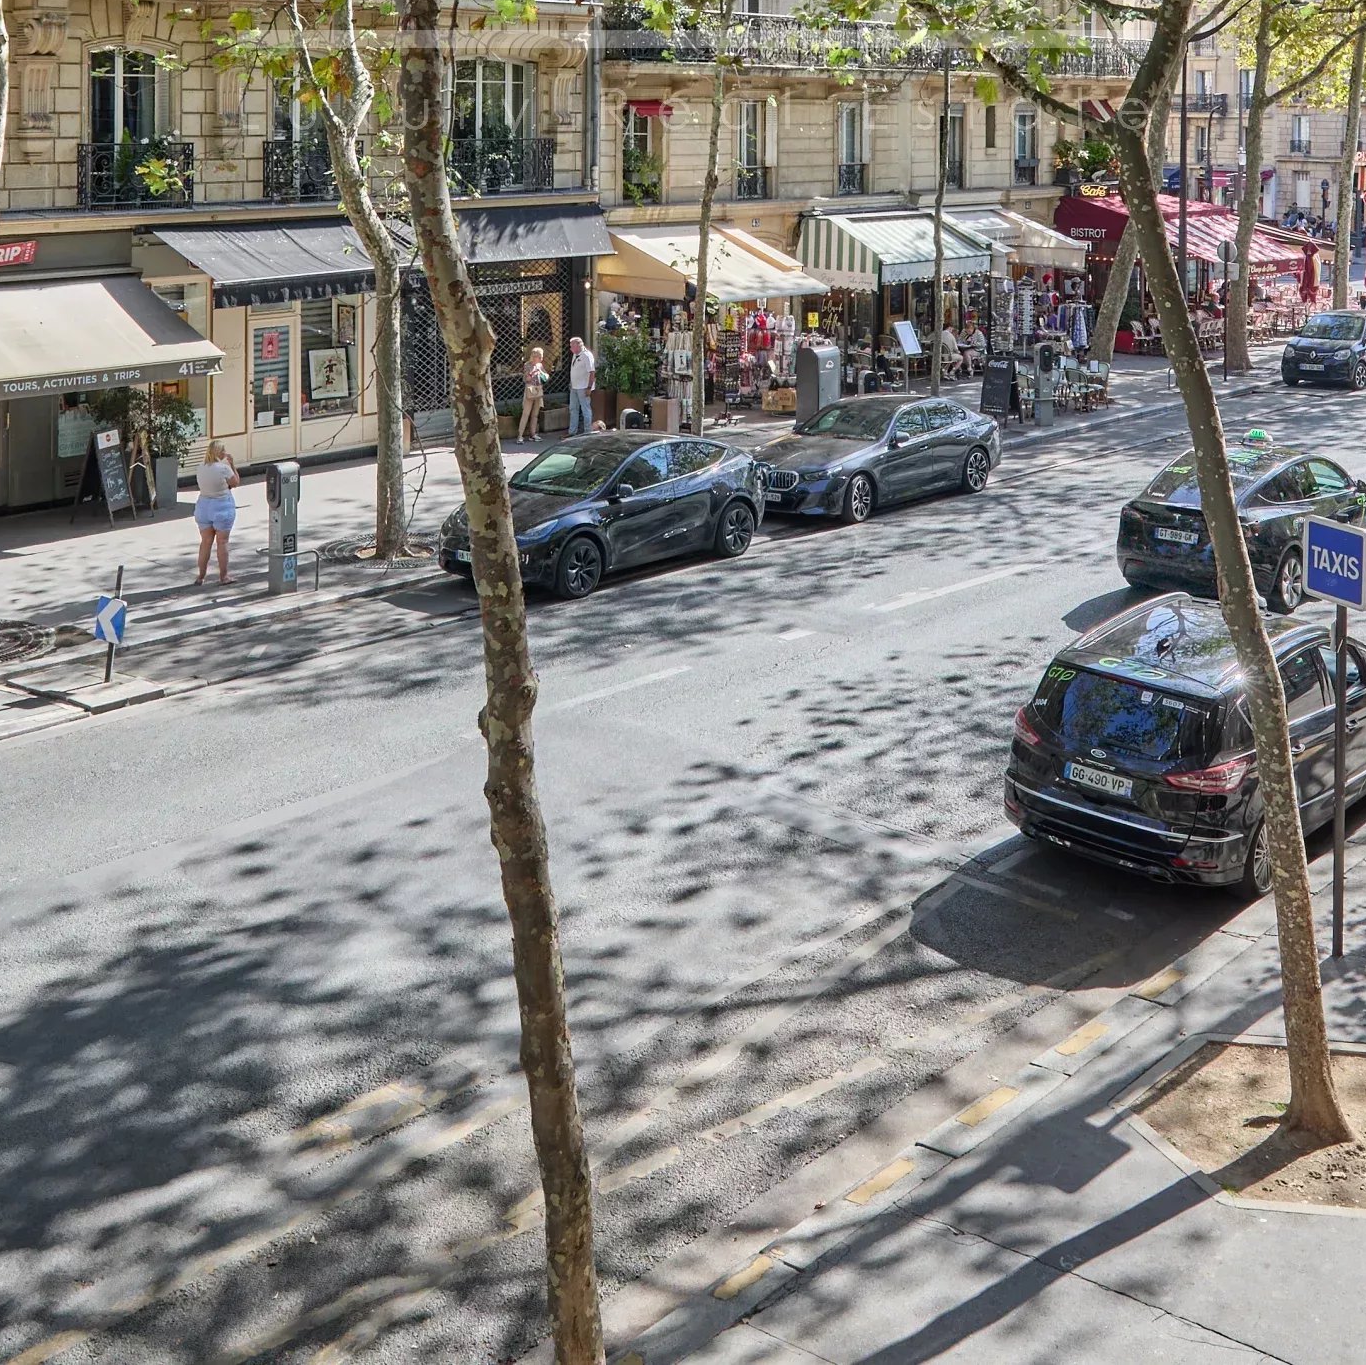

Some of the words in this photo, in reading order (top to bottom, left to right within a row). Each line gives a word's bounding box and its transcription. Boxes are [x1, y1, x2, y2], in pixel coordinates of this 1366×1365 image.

[1070, 227, 1108, 239] BISTROT
[178, 361, 195, 376] 41
[3, 381, 41, 394] TOURS,
[43, 375, 98, 391] ACTIVITIES
[102, 372, 109, 383] &
[113, 369, 141, 381] TRIPS
[1311, 545, 1360, 581] TAXIS
